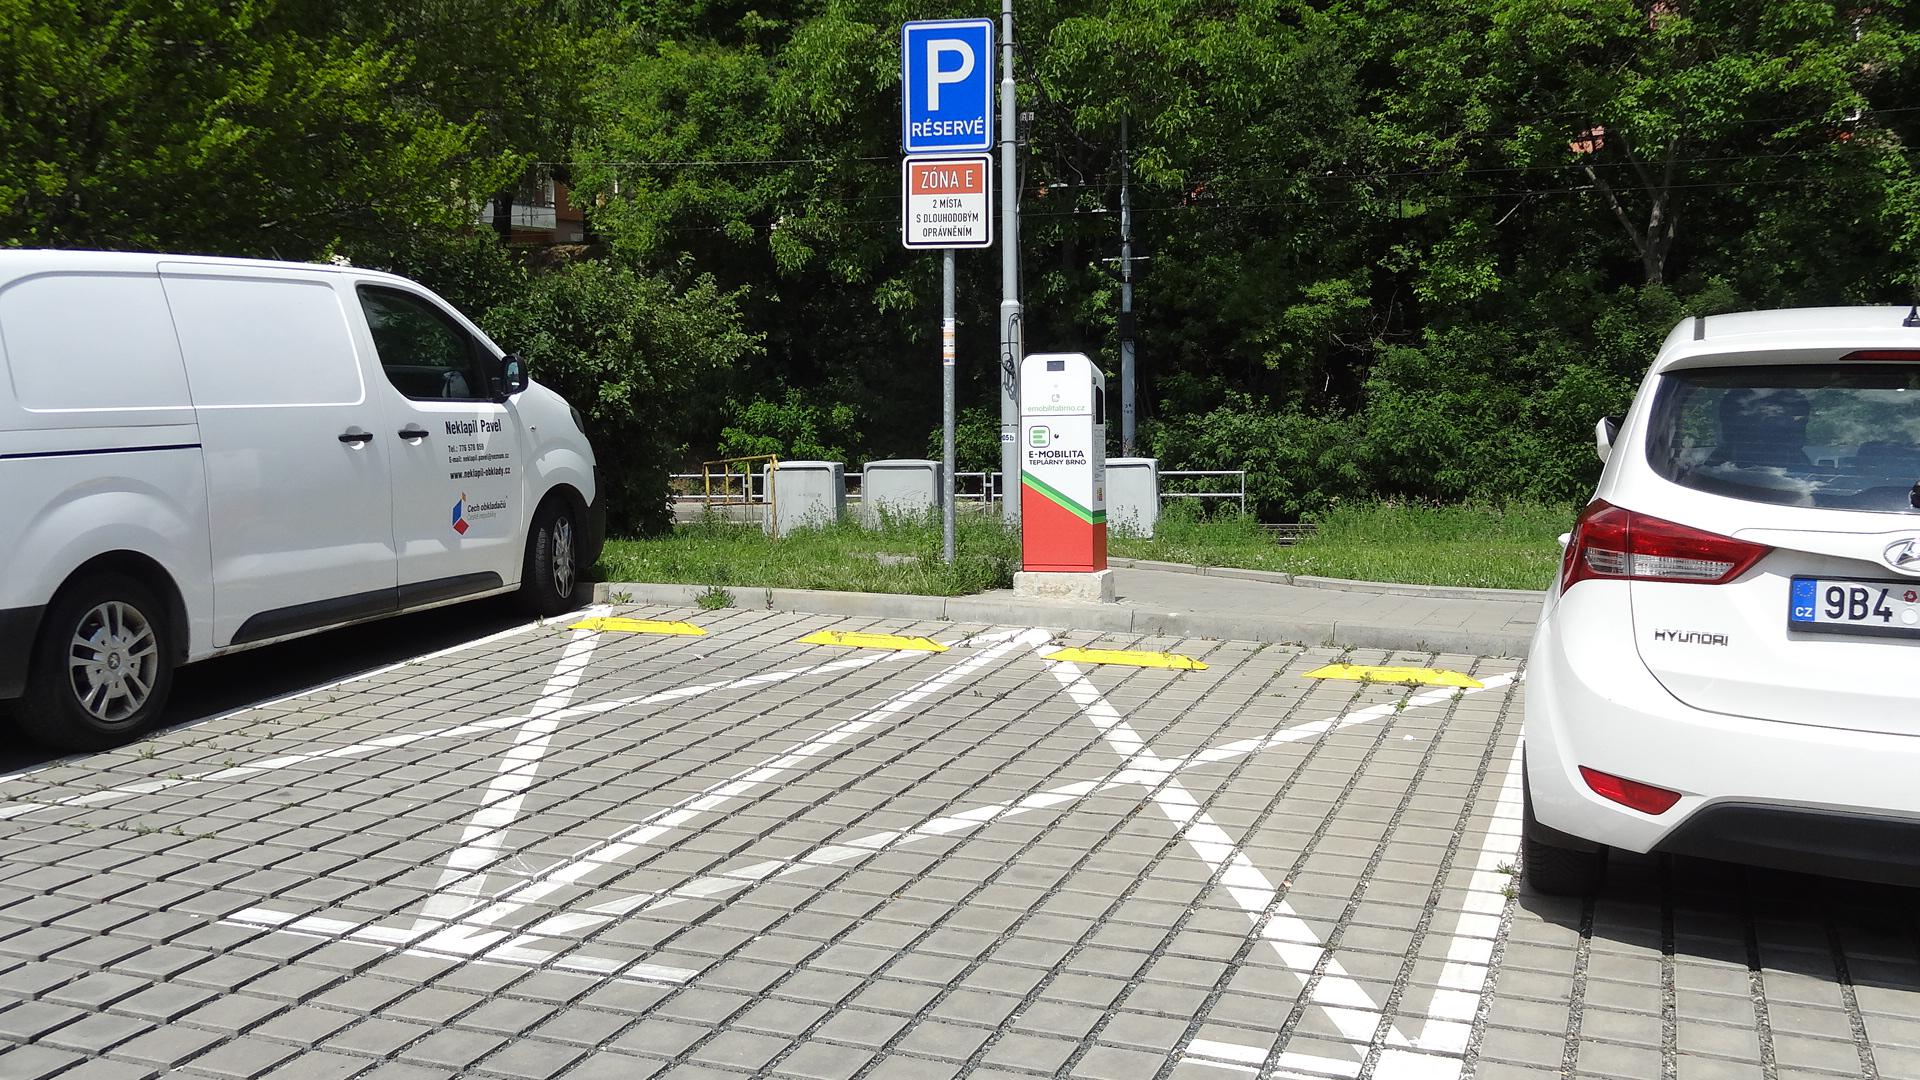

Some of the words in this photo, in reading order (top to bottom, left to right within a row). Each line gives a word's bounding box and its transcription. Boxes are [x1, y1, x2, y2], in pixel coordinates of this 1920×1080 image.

[927, 39, 975, 111] P
[912, 116, 984, 137] RÉSERVÉ
[921, 167, 959, 189] ZÓNA
[965, 169, 974, 188] E
[932, 199, 937, 208] 2
[939, 197, 962, 208] MÍSTA
[916, 214, 921, 223] S
[923, 211, 979, 223] DLOUHODOBÝM
[922, 225, 972, 237] OPRÁVNĚNÍM
[445, 420, 478, 436] Neklapil
[480, 418, 501, 433] Pavel
[1028, 450, 1084, 458] E-MOBILITA
[1795, 606, 1812, 618] CZ
[1824, 585, 1893, 623] 9B4
[1654, 628, 1728, 647] HYUNDAI
